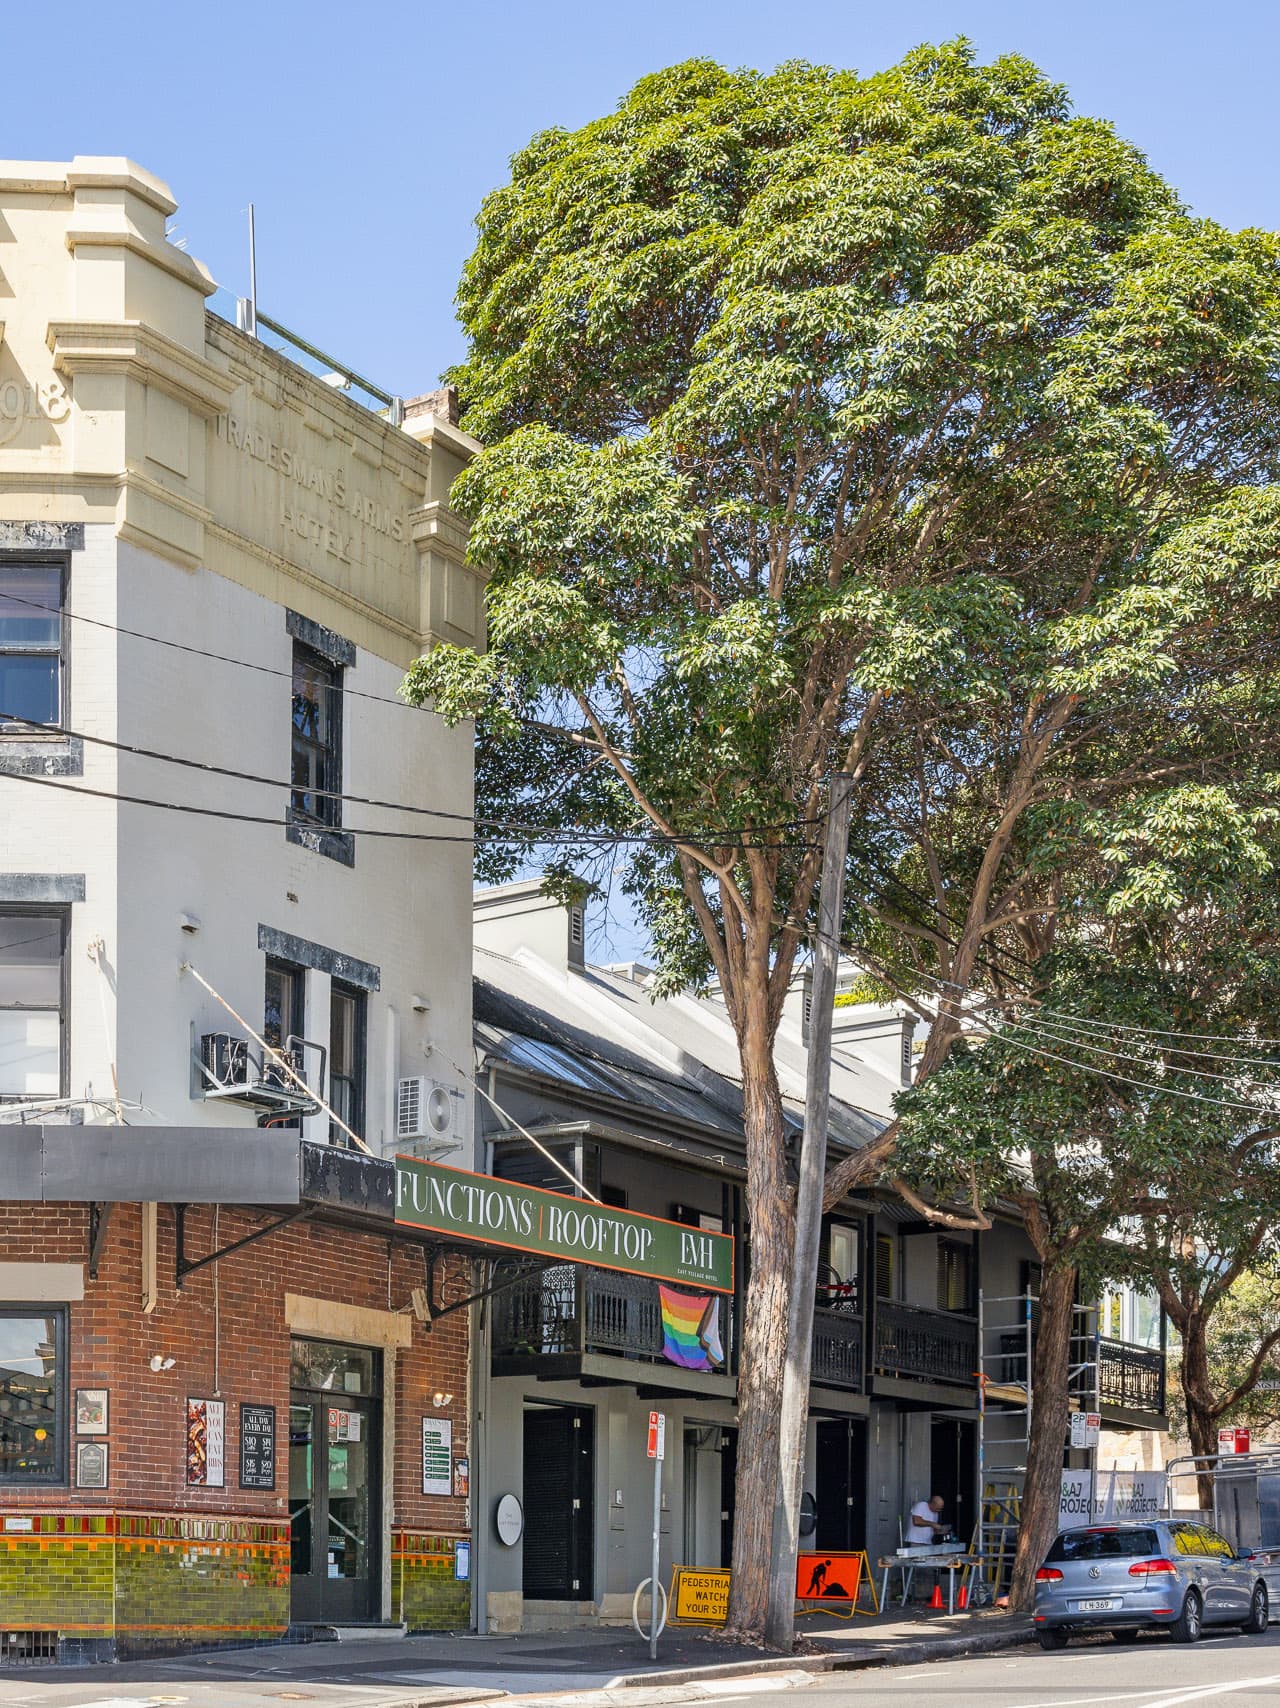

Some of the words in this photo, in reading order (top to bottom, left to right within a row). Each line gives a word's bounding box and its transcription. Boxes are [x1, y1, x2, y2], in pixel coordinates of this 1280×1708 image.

[396, 1169, 533, 1236] FUNCTIONS
[548, 1205, 652, 1261] ROOFTOP
[681, 1232, 713, 1269] EVH
[1060, 1498, 1104, 1513] ROJECTS
[1126, 1498, 1158, 1512] PROJECTS
[682, 1577, 729, 1588] PEDESTRIA
[696, 1591, 726, 1601] WATCH
[687, 1603, 709, 1613] YOUR
[712, 1605, 727, 1614] STE
